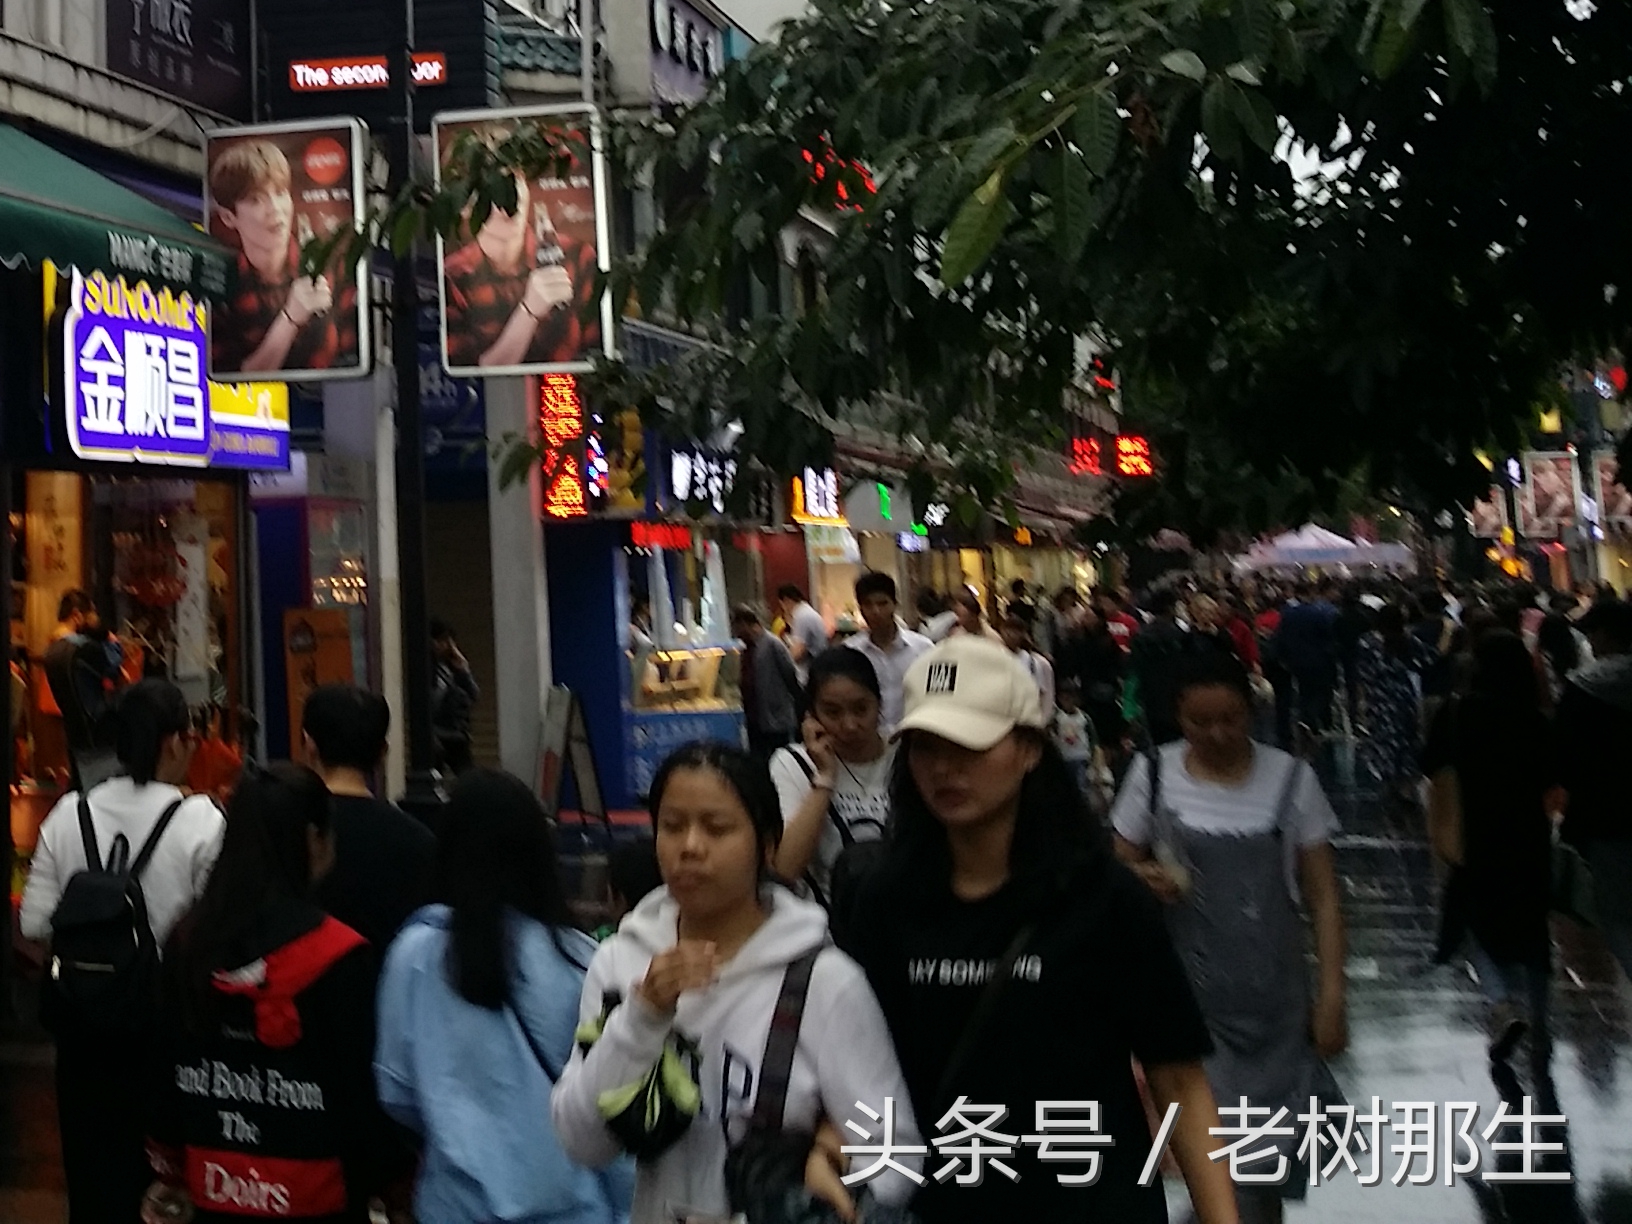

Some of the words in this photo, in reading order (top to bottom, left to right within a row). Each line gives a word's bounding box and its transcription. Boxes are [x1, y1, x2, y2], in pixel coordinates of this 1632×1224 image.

[292, 63, 330, 88] The
[330, 61, 390, 86] secon
[79, 324, 205, 441] 金顺昌
[174, 1056, 210, 1098] and
[264, 1067, 326, 1112] From
[216, 1109, 262, 1146] The
